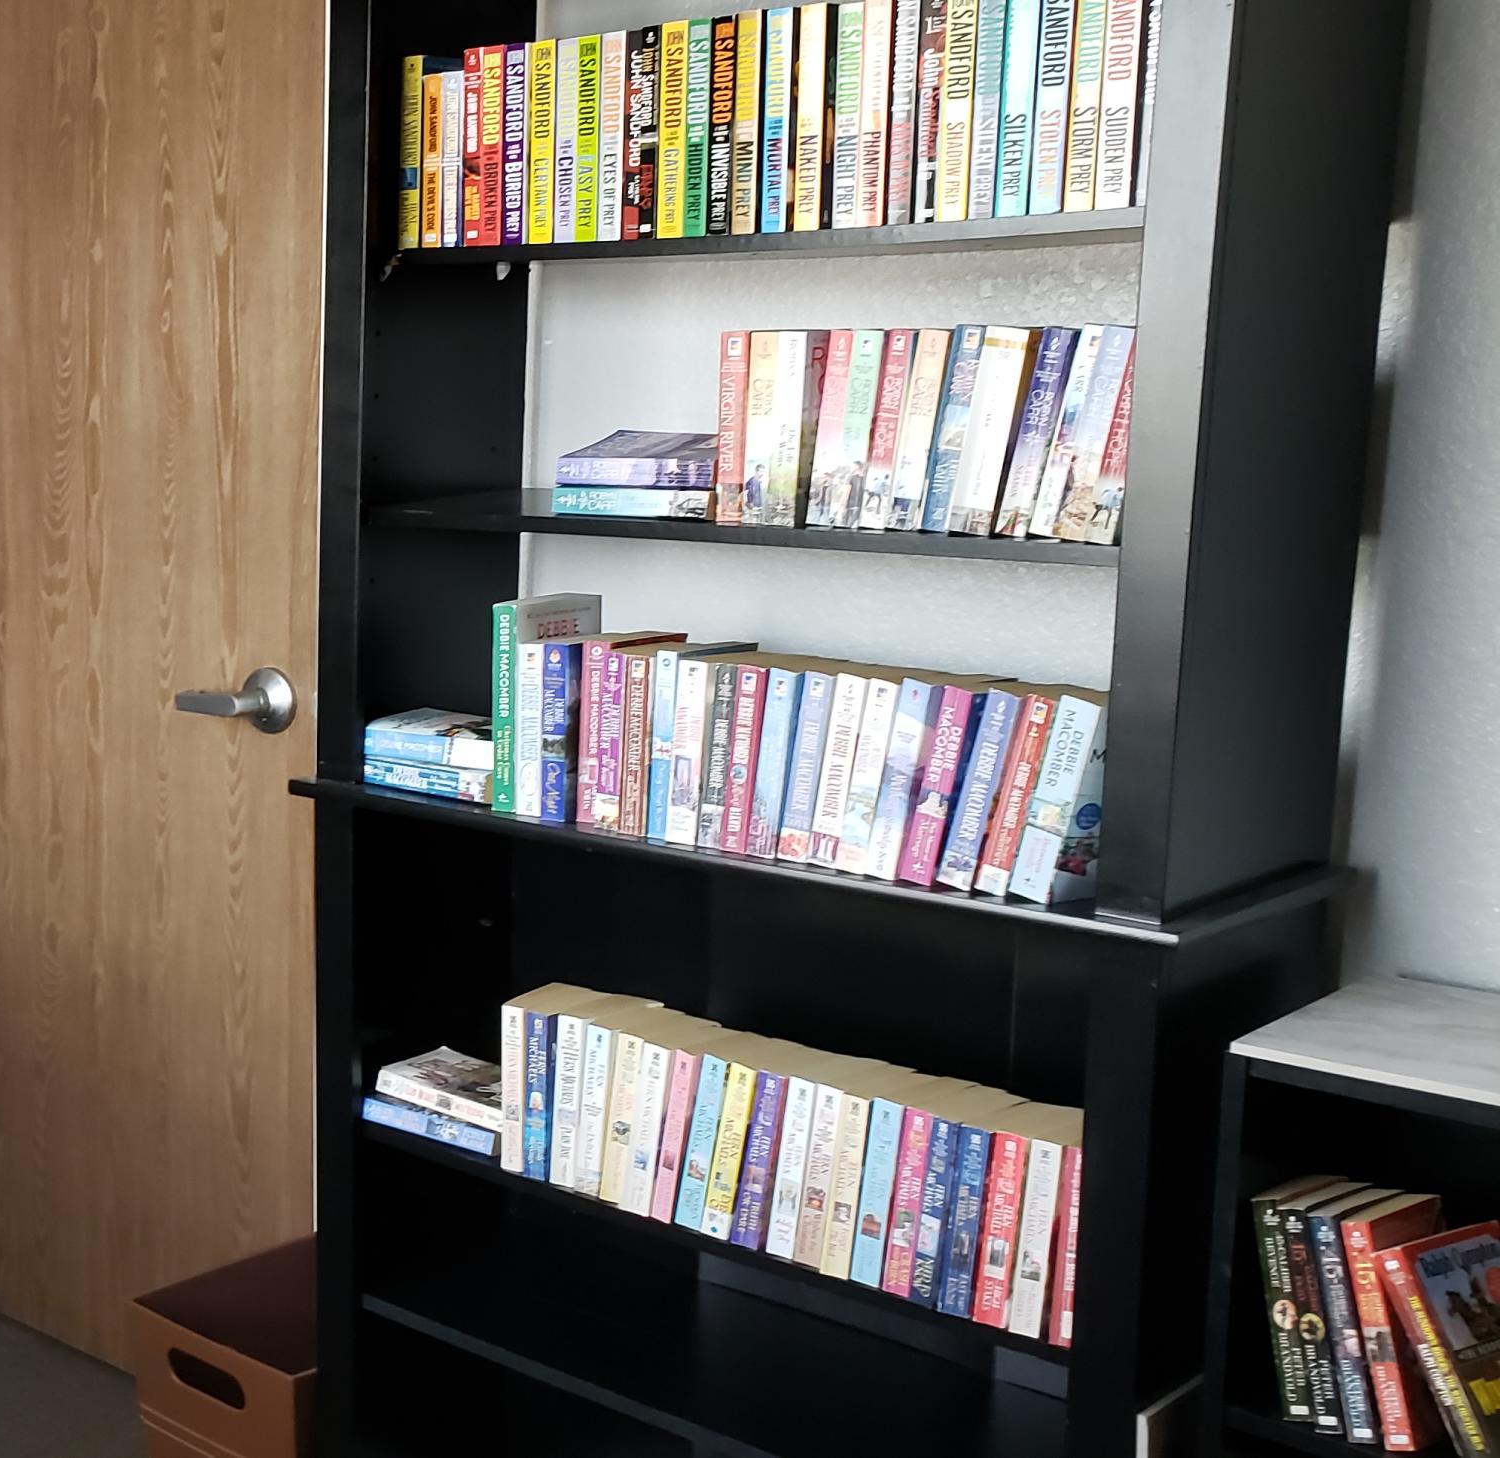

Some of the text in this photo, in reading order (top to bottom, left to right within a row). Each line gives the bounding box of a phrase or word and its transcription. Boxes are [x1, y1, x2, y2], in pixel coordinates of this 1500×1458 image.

[482, 67, 501, 145] SANDFORD
[533, 62, 552, 139] SANDFORD
[603, 52, 622, 134] SANDFORD
[664, 47, 685, 209] SANDFORD GATHERING
[687, 38, 709, 190] SANDFORD HIDDEN
[711, 38, 733, 198] SANDFORD INVISIBLE
[836, 30, 861, 215] SANDFORD NIGHT PREY
[945, 9, 974, 171] SANDFORD SHADOW
[504, 63, 524, 208] SANDFORD BURIED
[579, 55, 598, 228] SANDFORD PREY
[766, 138, 784, 192] MORTAL
[799, 135, 819, 215] NAKED PREY
[862, 131, 882, 189] PHANTOM
[1002, 113, 1027, 197] SILKEN PREY
[1038, 109, 1062, 164] STOLEN
[1070, 106, 1097, 193] STORM PREY
[1103, 106, 1130, 194] SUDDEN PREY
[558, 156, 574, 204] CHOSEN
[734, 141, 755, 218] MIND PREY
[719, 375, 734, 473] VIRGIN RIVER
[537, 618, 581, 640] DEBBIE
[926, 706, 957, 786] MACOMBER
[1045, 709, 1078, 790] MACOMBER
[1067, 730, 1086, 777] DEBBIE
